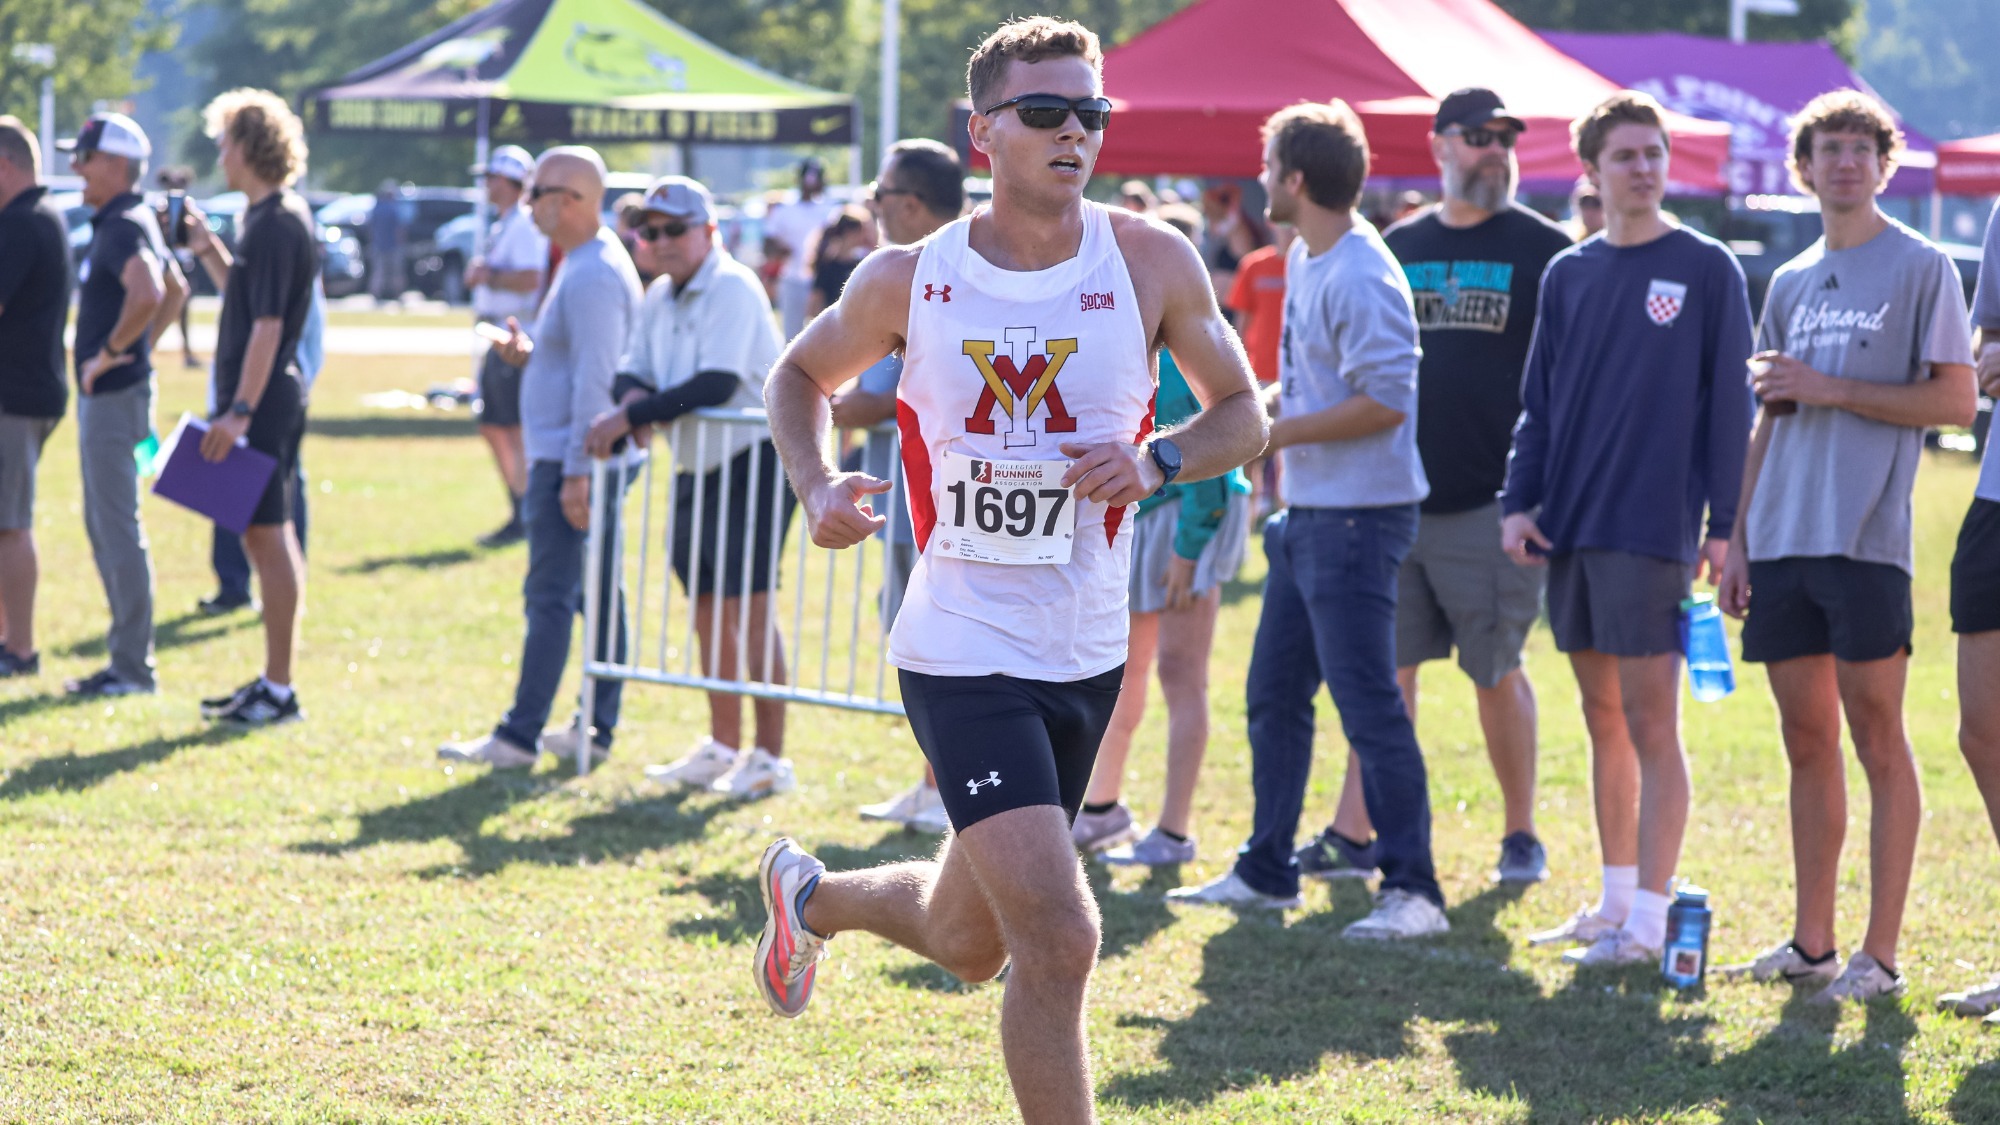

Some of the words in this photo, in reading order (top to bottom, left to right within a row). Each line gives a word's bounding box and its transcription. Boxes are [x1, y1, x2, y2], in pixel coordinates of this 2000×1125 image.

[571, 107, 660, 138] TRACK
[695, 110, 778, 140] FIELD
[994, 470, 1043, 479] RUNNING
[947, 480, 1069, 537] 1697
